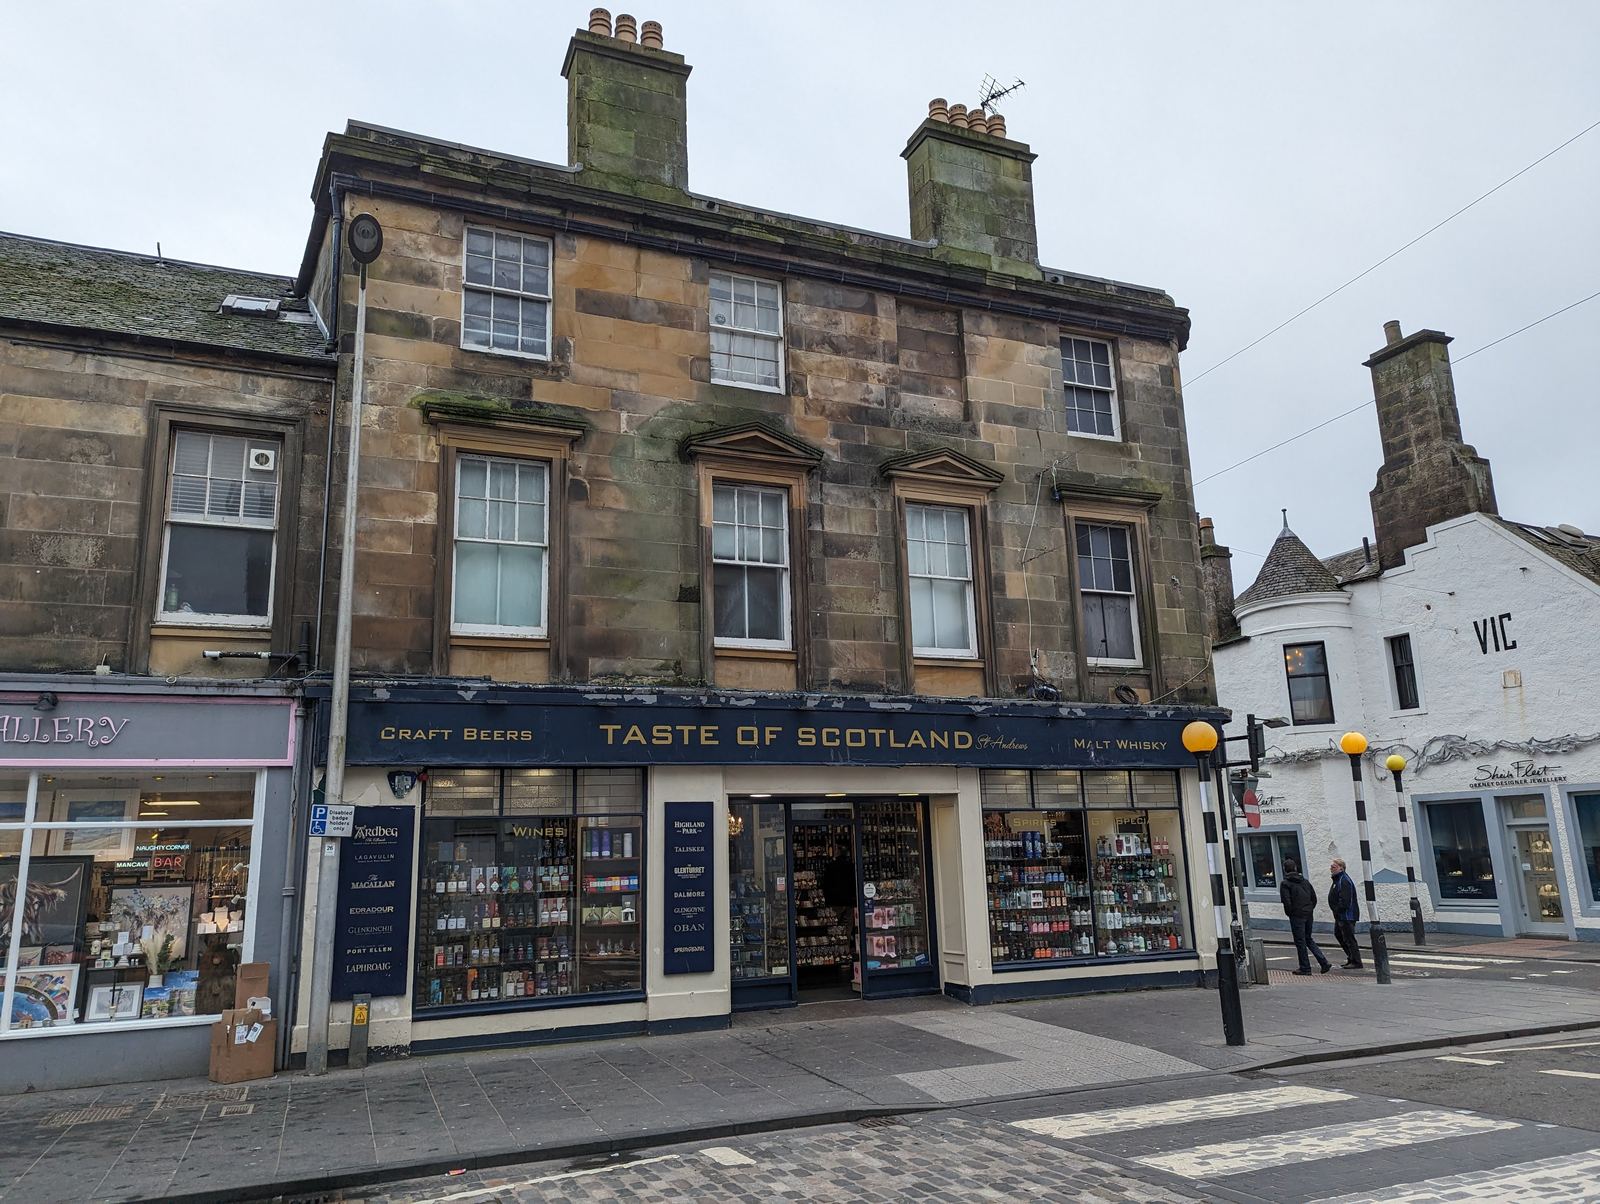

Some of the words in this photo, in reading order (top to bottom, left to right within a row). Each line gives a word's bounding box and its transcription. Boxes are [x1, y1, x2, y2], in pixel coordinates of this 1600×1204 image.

[1473, 612, 1517, 655] VIC
[380, 727, 453, 740] CRAFT
[463, 728, 533, 741] BEERS
[599, 724, 720, 745] TASTE
[736, 726, 783, 746] OF
[797, 727, 973, 749] SCOTLAND
[989, 735, 1029, 751] Andrews
[1116, 739, 1168, 750] WHISKY
[316, 807, 326, 819] P
[512, 826, 564, 837] WINES
[136, 844, 165, 852] NAUGHTY
[154, 856, 182, 867] BAR
[350, 880, 396, 890] MACALLAN
[674, 890, 705, 898] DALMORE
[349, 905, 394, 915] EDRADOUR
[673, 923, 705, 932] OBAN
[345, 962, 391, 973] LAPHROAIG
